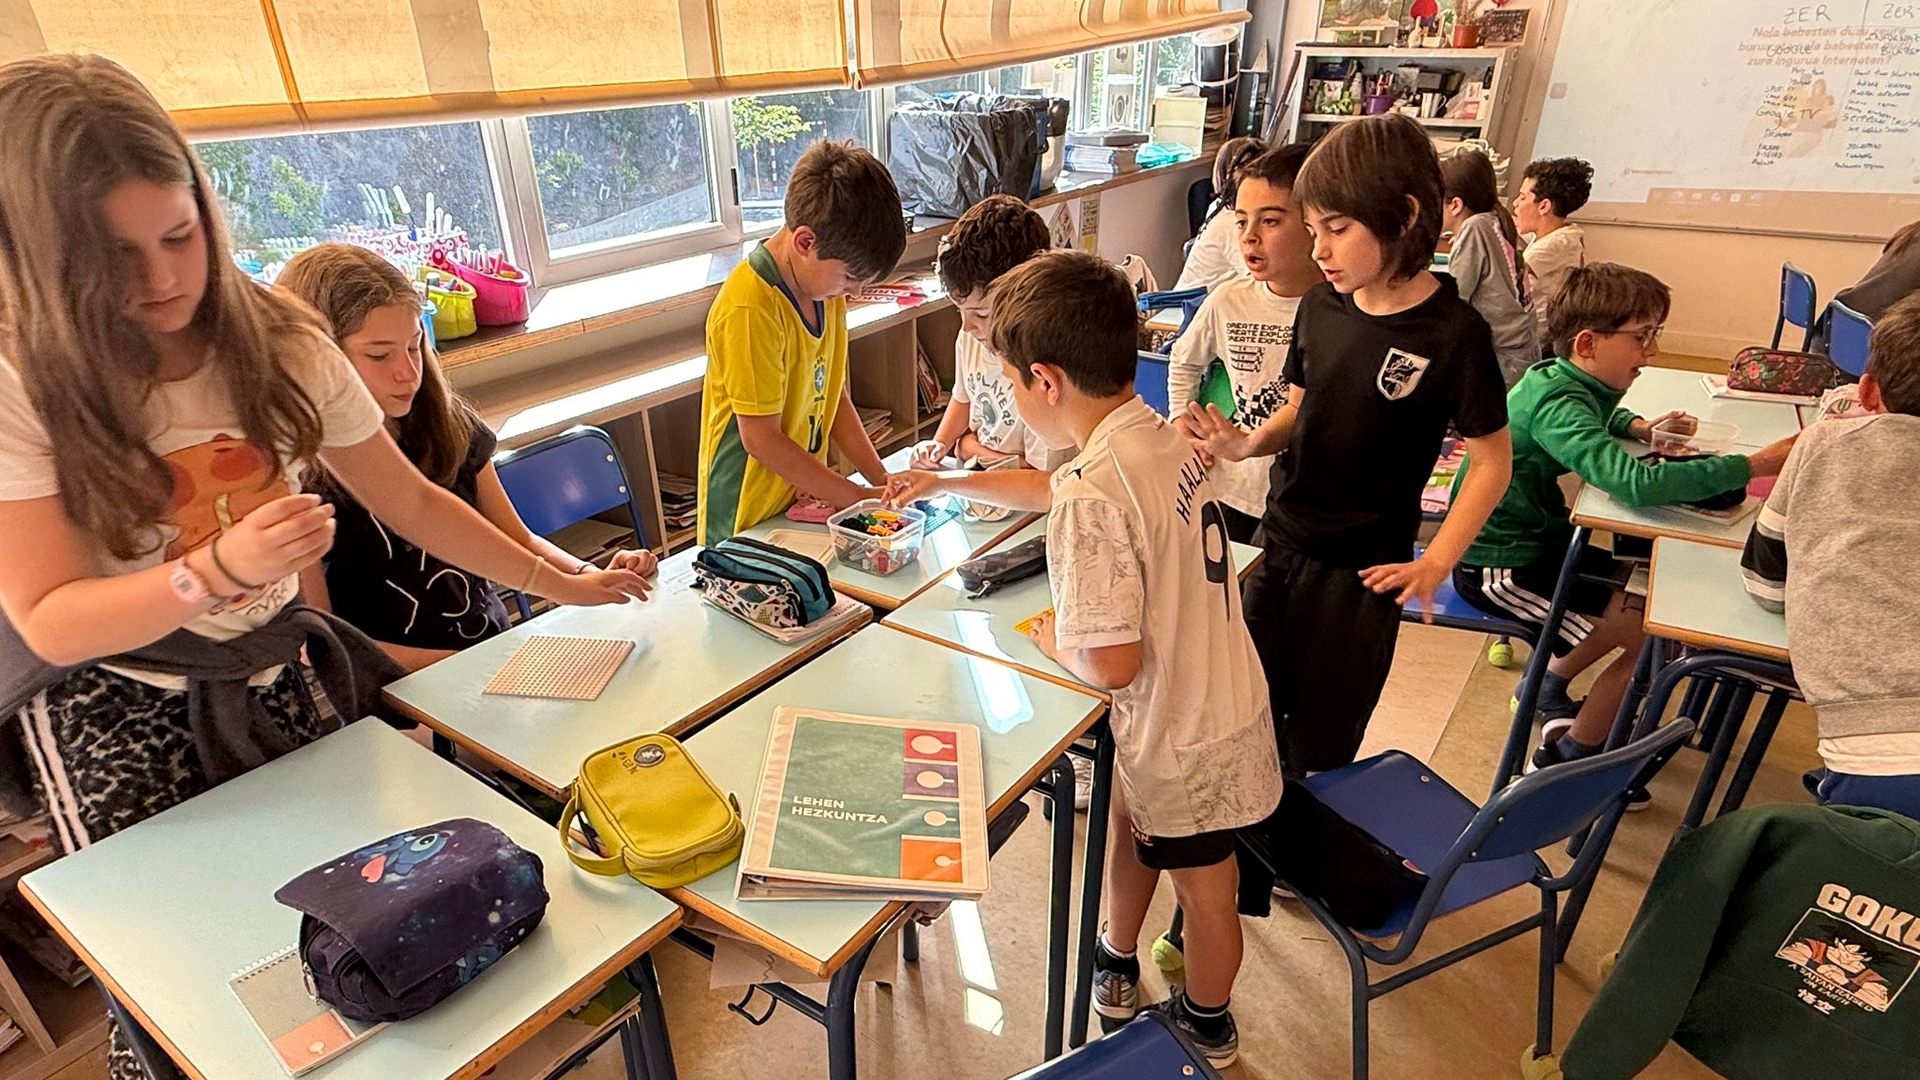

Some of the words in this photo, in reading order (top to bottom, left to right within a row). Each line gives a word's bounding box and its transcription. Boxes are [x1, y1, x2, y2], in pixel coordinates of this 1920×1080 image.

[1783, 4, 1831, 25] ZER
[1882, 3, 1920, 19] ZER
[1752, 27, 1780, 38] Nola
[1766, 44, 1812, 57] GOOGLE
[1756, 106, 1794, 131] Google
[1799, 109, 1822, 120] TV
[1259, 330, 1293, 339] EXPLO
[1261, 324, 1294, 332] EXPLO
[1258, 337, 1292, 346] EXPLO
[1176, 457, 1209, 526] HAALA
[793, 795, 845, 809] LEHEN
[791, 806, 888, 824] HEZKUNTZA
[1799, 967, 1834, 991] SAIYAN
[1835, 988, 1874, 1012] RAISED
[1803, 978, 1817, 989] ON
[1818, 987, 1850, 1005] EARTH
